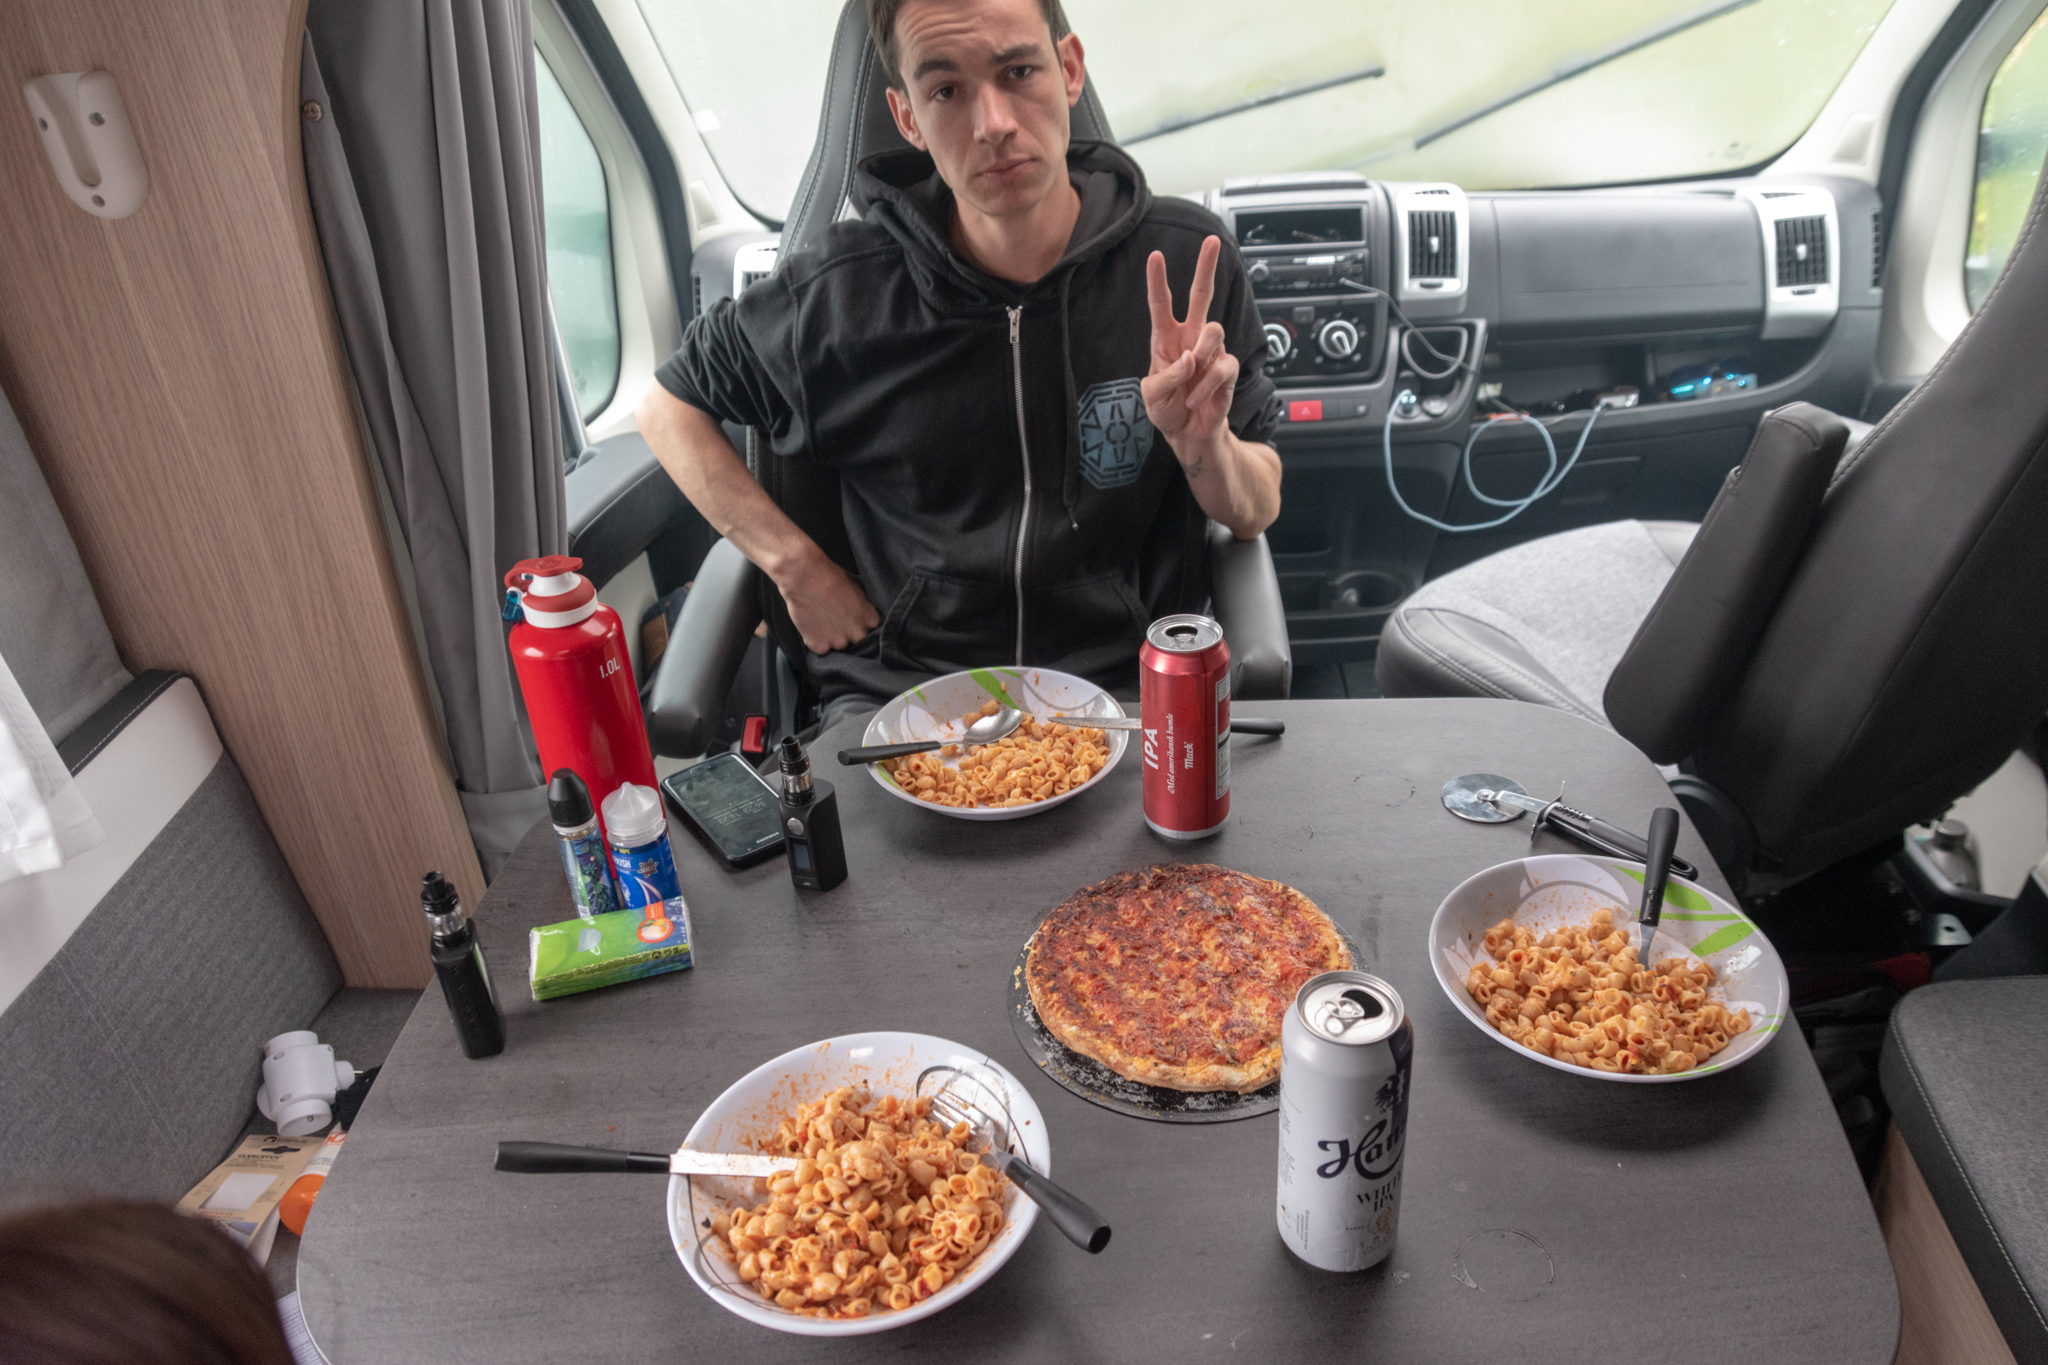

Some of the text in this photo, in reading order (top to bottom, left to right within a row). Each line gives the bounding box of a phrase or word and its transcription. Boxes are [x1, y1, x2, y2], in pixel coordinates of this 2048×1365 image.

[599, 657, 621, 679] 1.0L
[1143, 728, 1159, 770] IPA
[1166, 735, 1175, 773] amerikansk
[1183, 742, 1194, 769] Mack
[1166, 773, 1175, 794] Med
